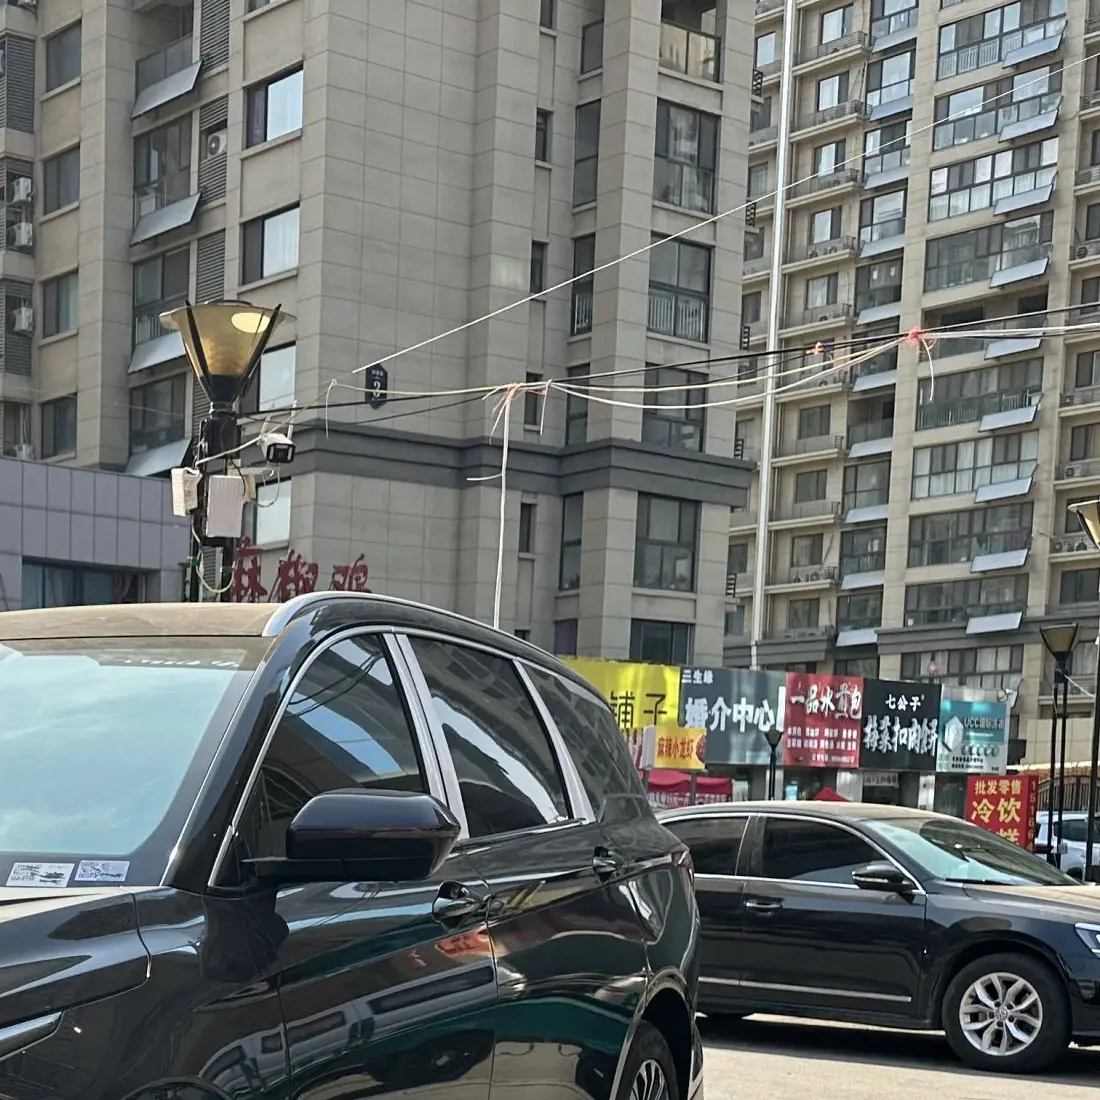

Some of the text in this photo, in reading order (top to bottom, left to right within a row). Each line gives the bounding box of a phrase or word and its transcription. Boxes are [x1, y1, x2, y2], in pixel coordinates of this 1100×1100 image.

[885, 693, 921, 712] 七公子
[685, 696, 776, 732] 婚介中心
[974, 779, 1022, 795] 批发零售
[971, 798, 1022, 824] 冷饮
